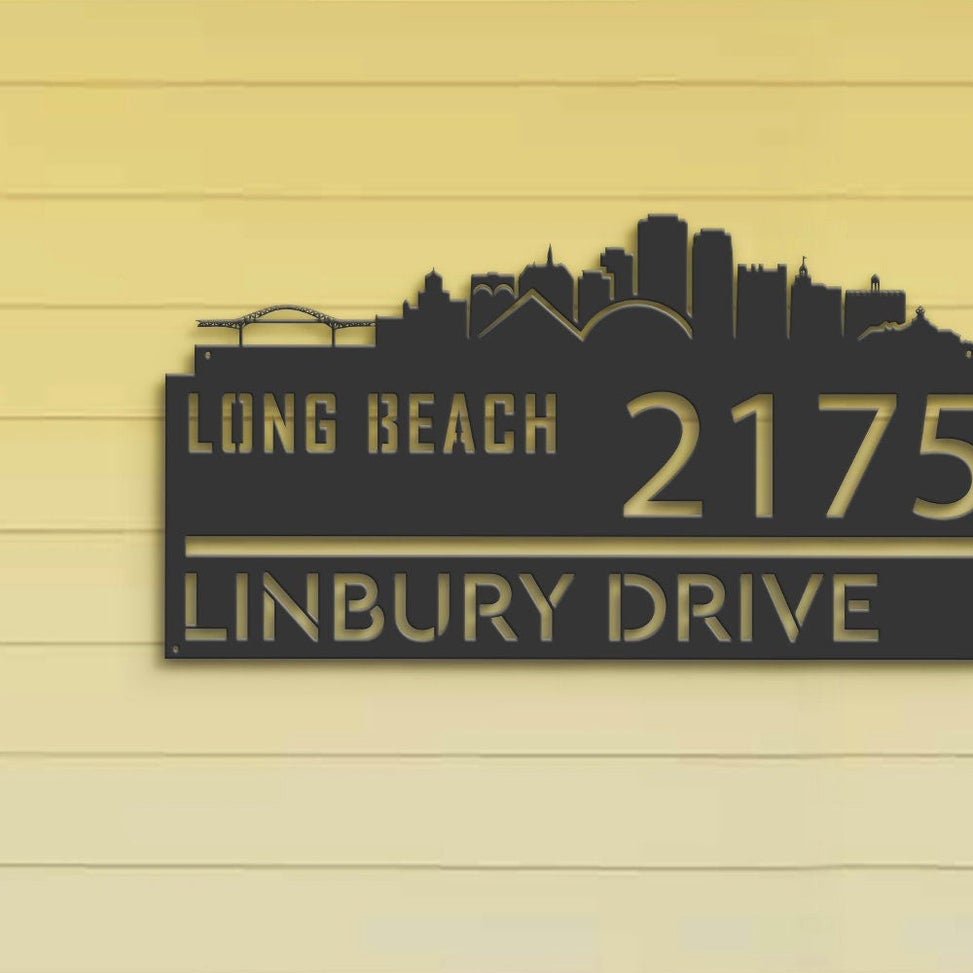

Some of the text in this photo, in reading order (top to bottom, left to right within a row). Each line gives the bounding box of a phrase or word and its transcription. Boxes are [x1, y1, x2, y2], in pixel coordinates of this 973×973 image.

[187, 392, 557, 455] LONG BEACH
[184, 571, 880, 643] LINBURY DRIVE
